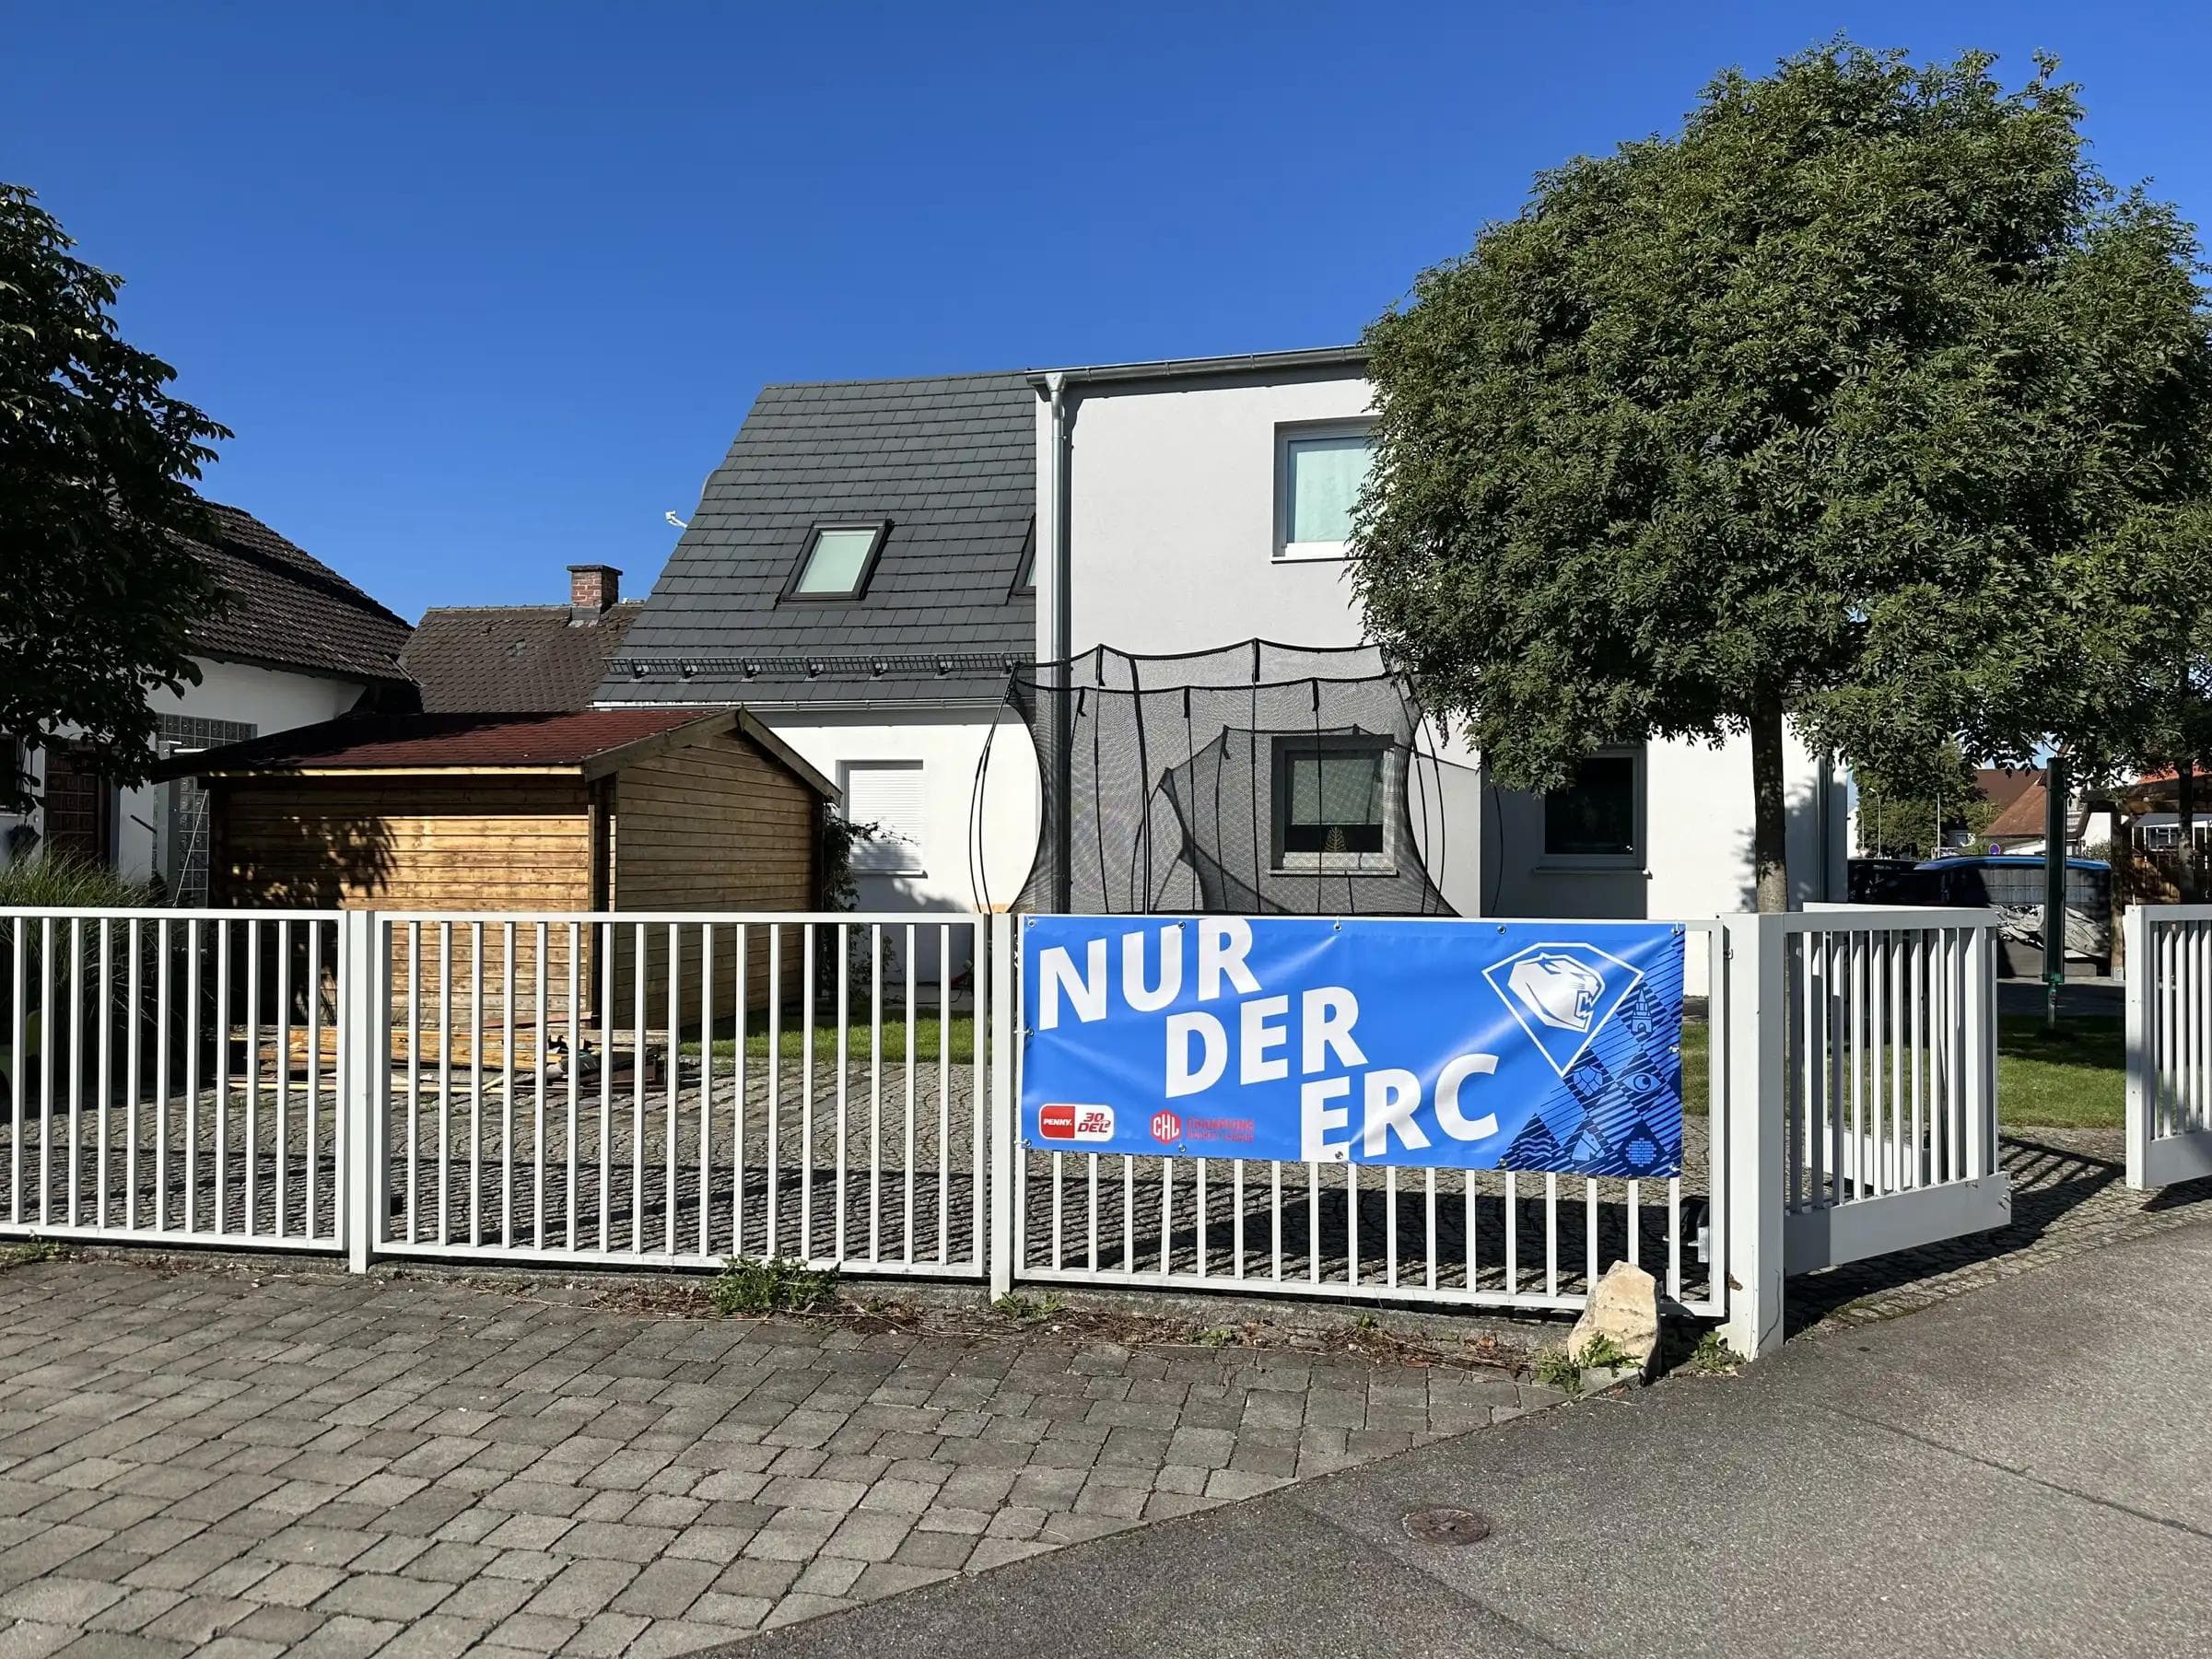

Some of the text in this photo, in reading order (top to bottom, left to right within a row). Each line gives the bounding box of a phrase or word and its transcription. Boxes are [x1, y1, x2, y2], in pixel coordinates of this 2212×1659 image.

[1039, 918, 1262, 1031] NUR
[1165, 987, 1369, 1098] DER
[1083, 1112, 1105, 1122] 30
[1153, 1114, 1179, 1140] CHL
[1301, 1053, 1499, 1162] ERC
